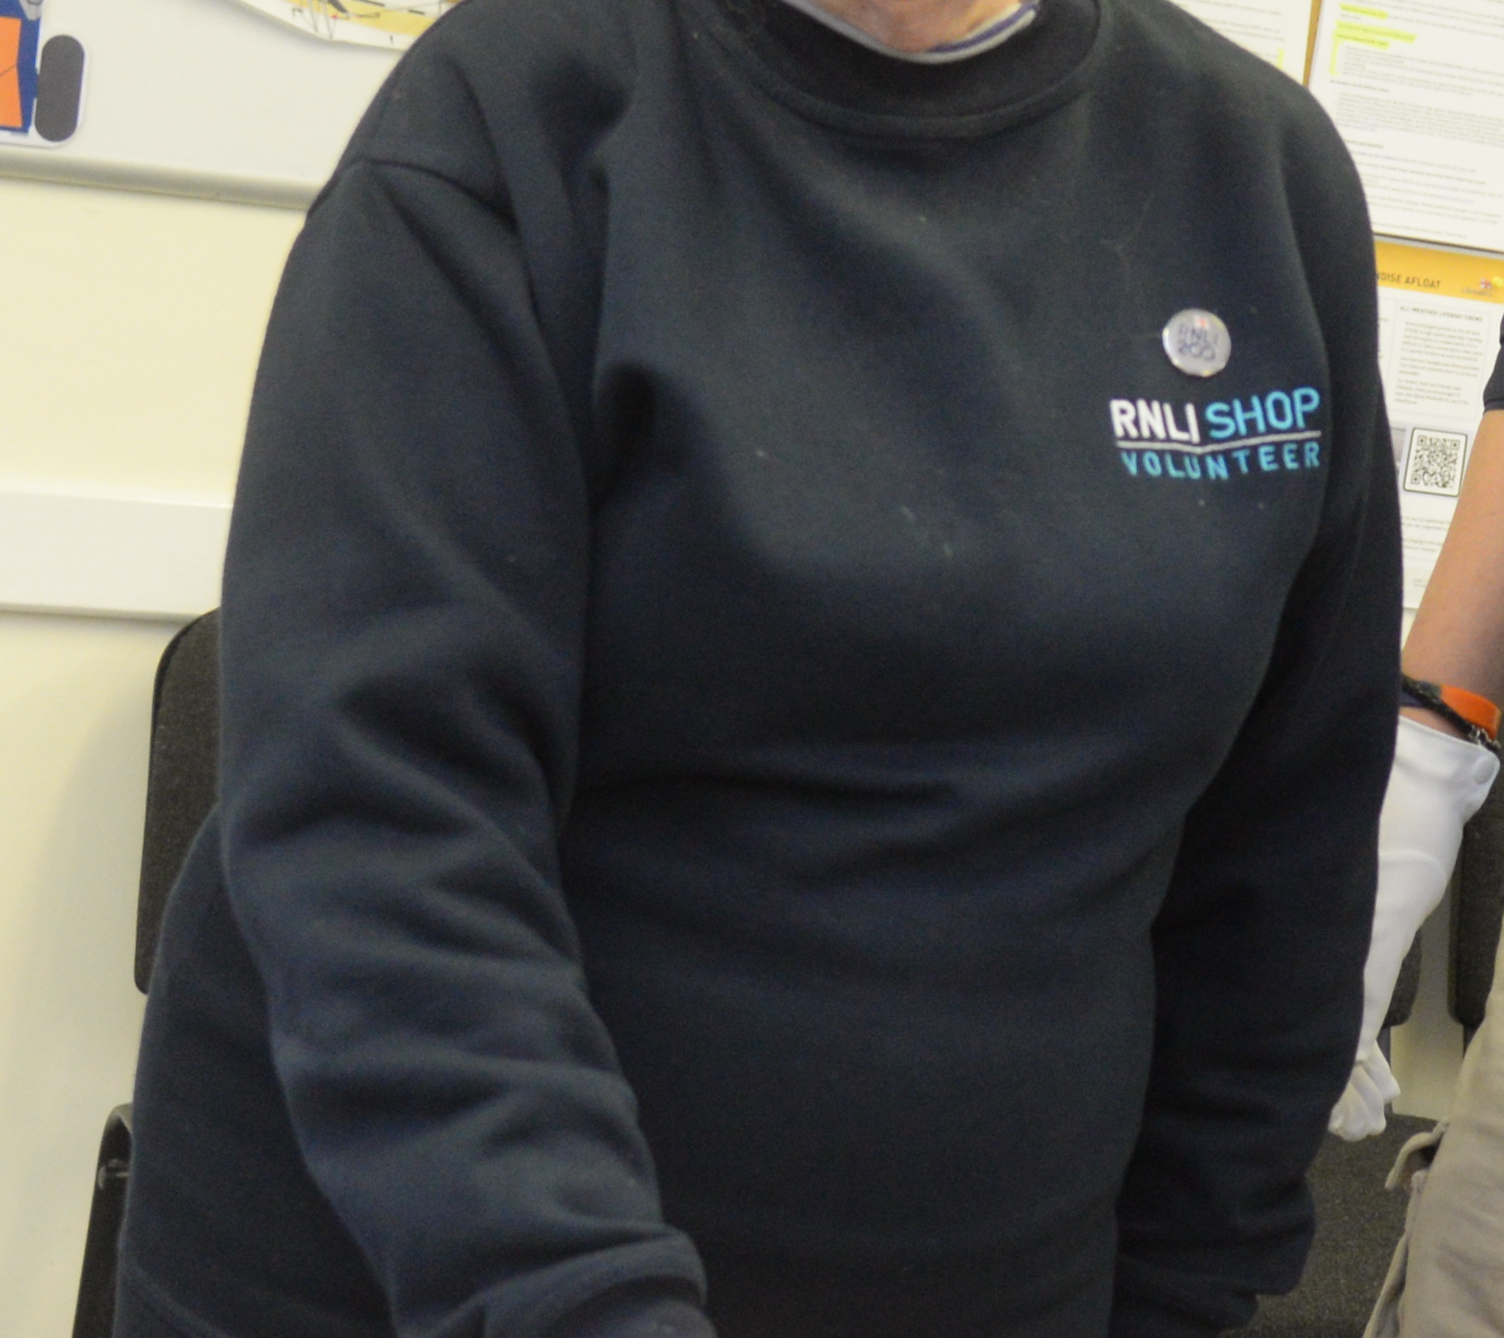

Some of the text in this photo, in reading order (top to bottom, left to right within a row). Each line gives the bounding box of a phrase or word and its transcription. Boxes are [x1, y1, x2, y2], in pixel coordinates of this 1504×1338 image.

[1404, 275, 1441, 289] AFLOAT
[1109, 386, 1320, 444] RNLI SHOP
[1120, 441, 1320, 480] VOLUNTEER
